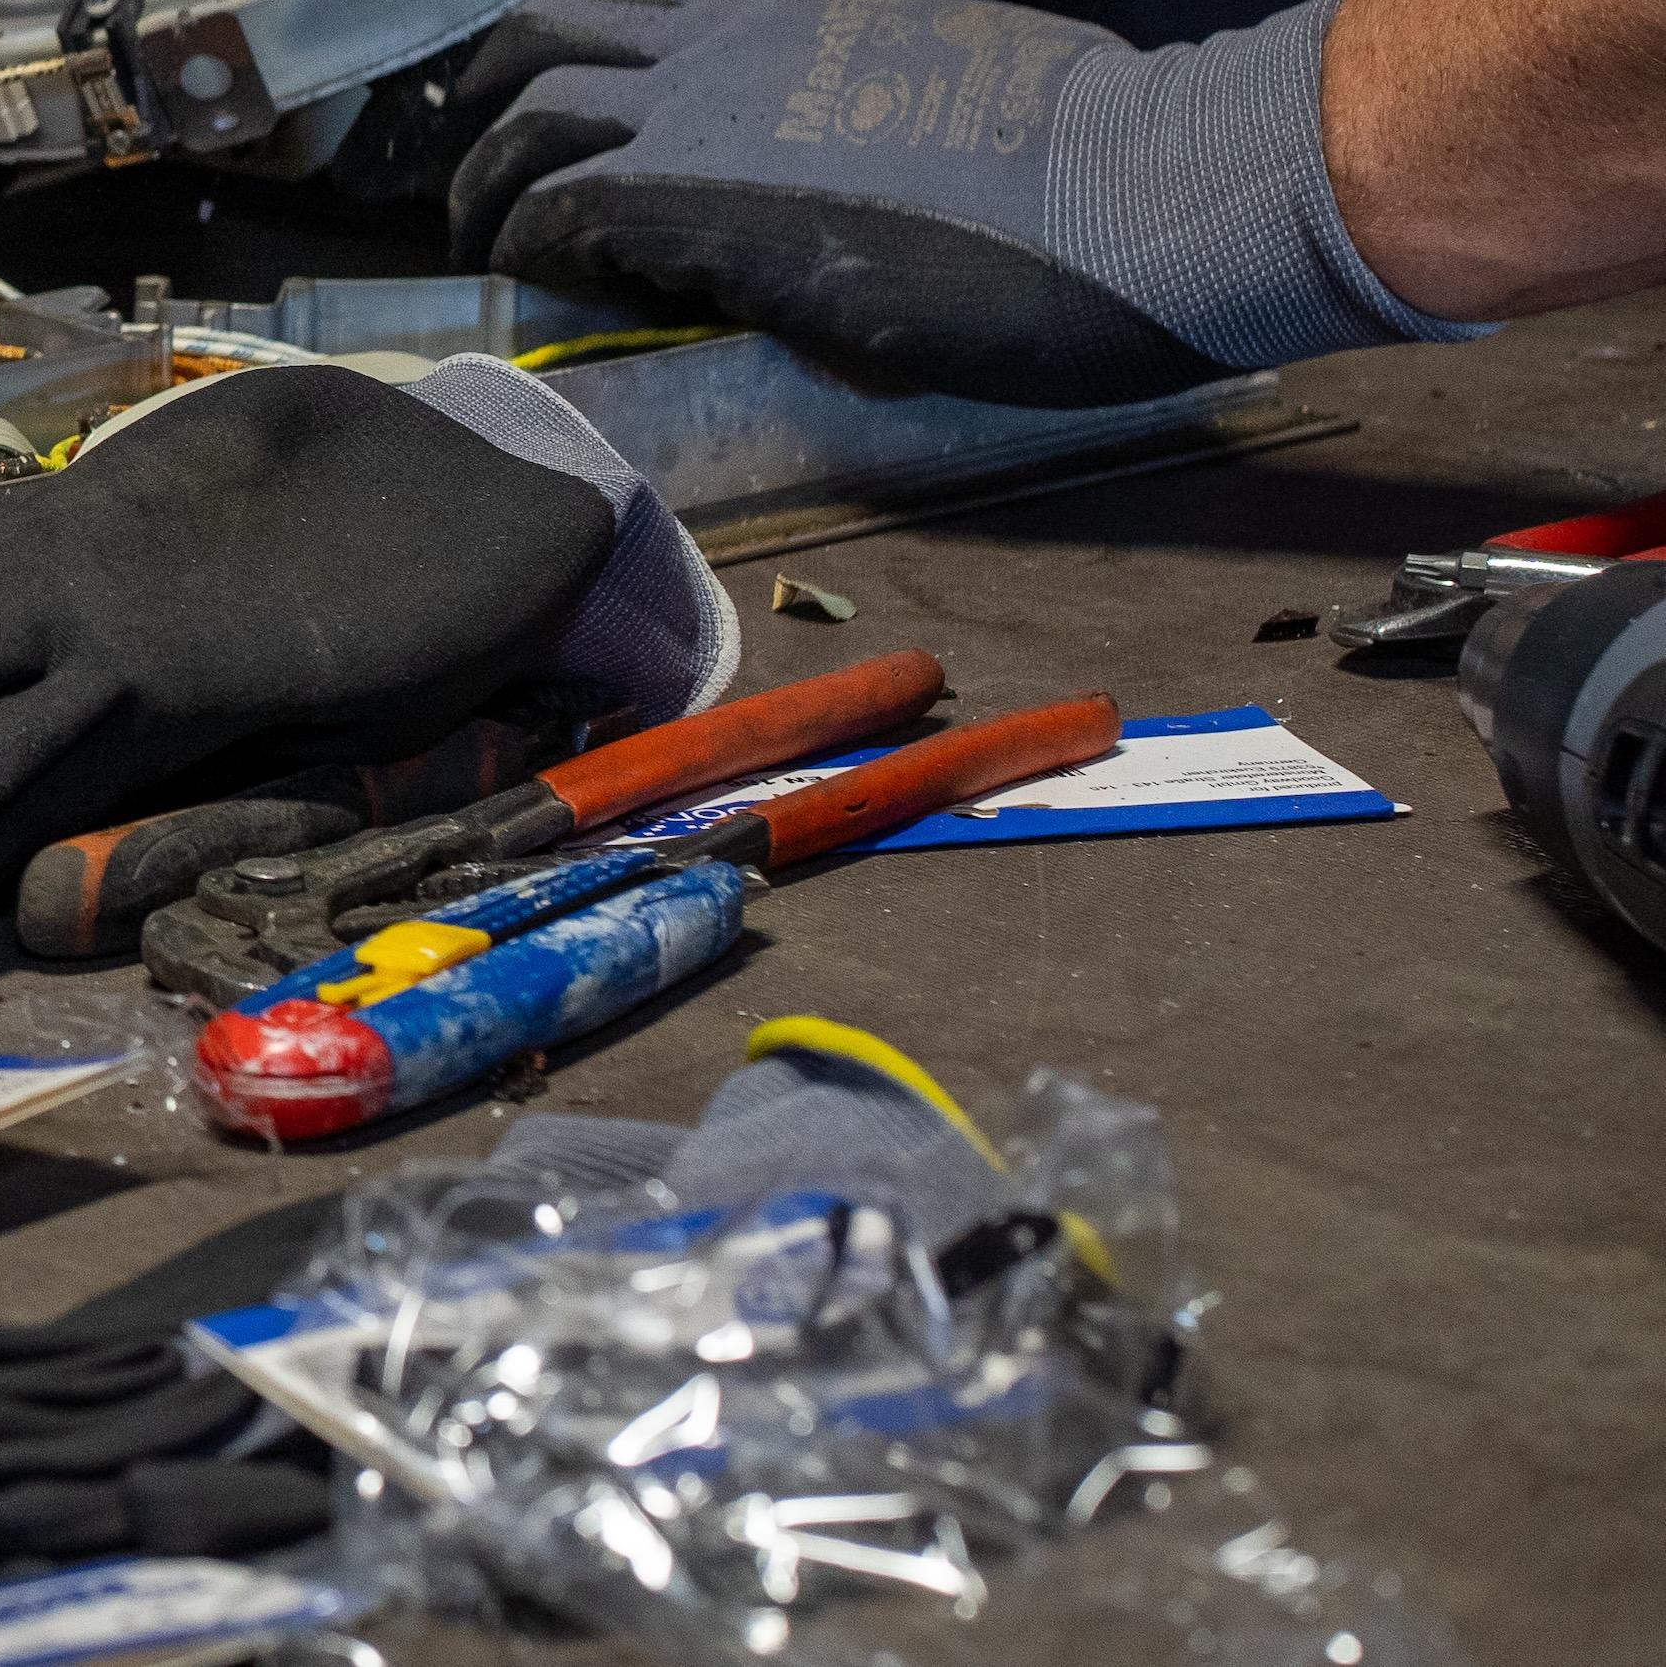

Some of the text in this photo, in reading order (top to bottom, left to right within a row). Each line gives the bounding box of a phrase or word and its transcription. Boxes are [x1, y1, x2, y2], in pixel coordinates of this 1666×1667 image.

[1208, 775, 1336, 789] Goodway GmbH
[1273, 780, 1344, 791] produced
